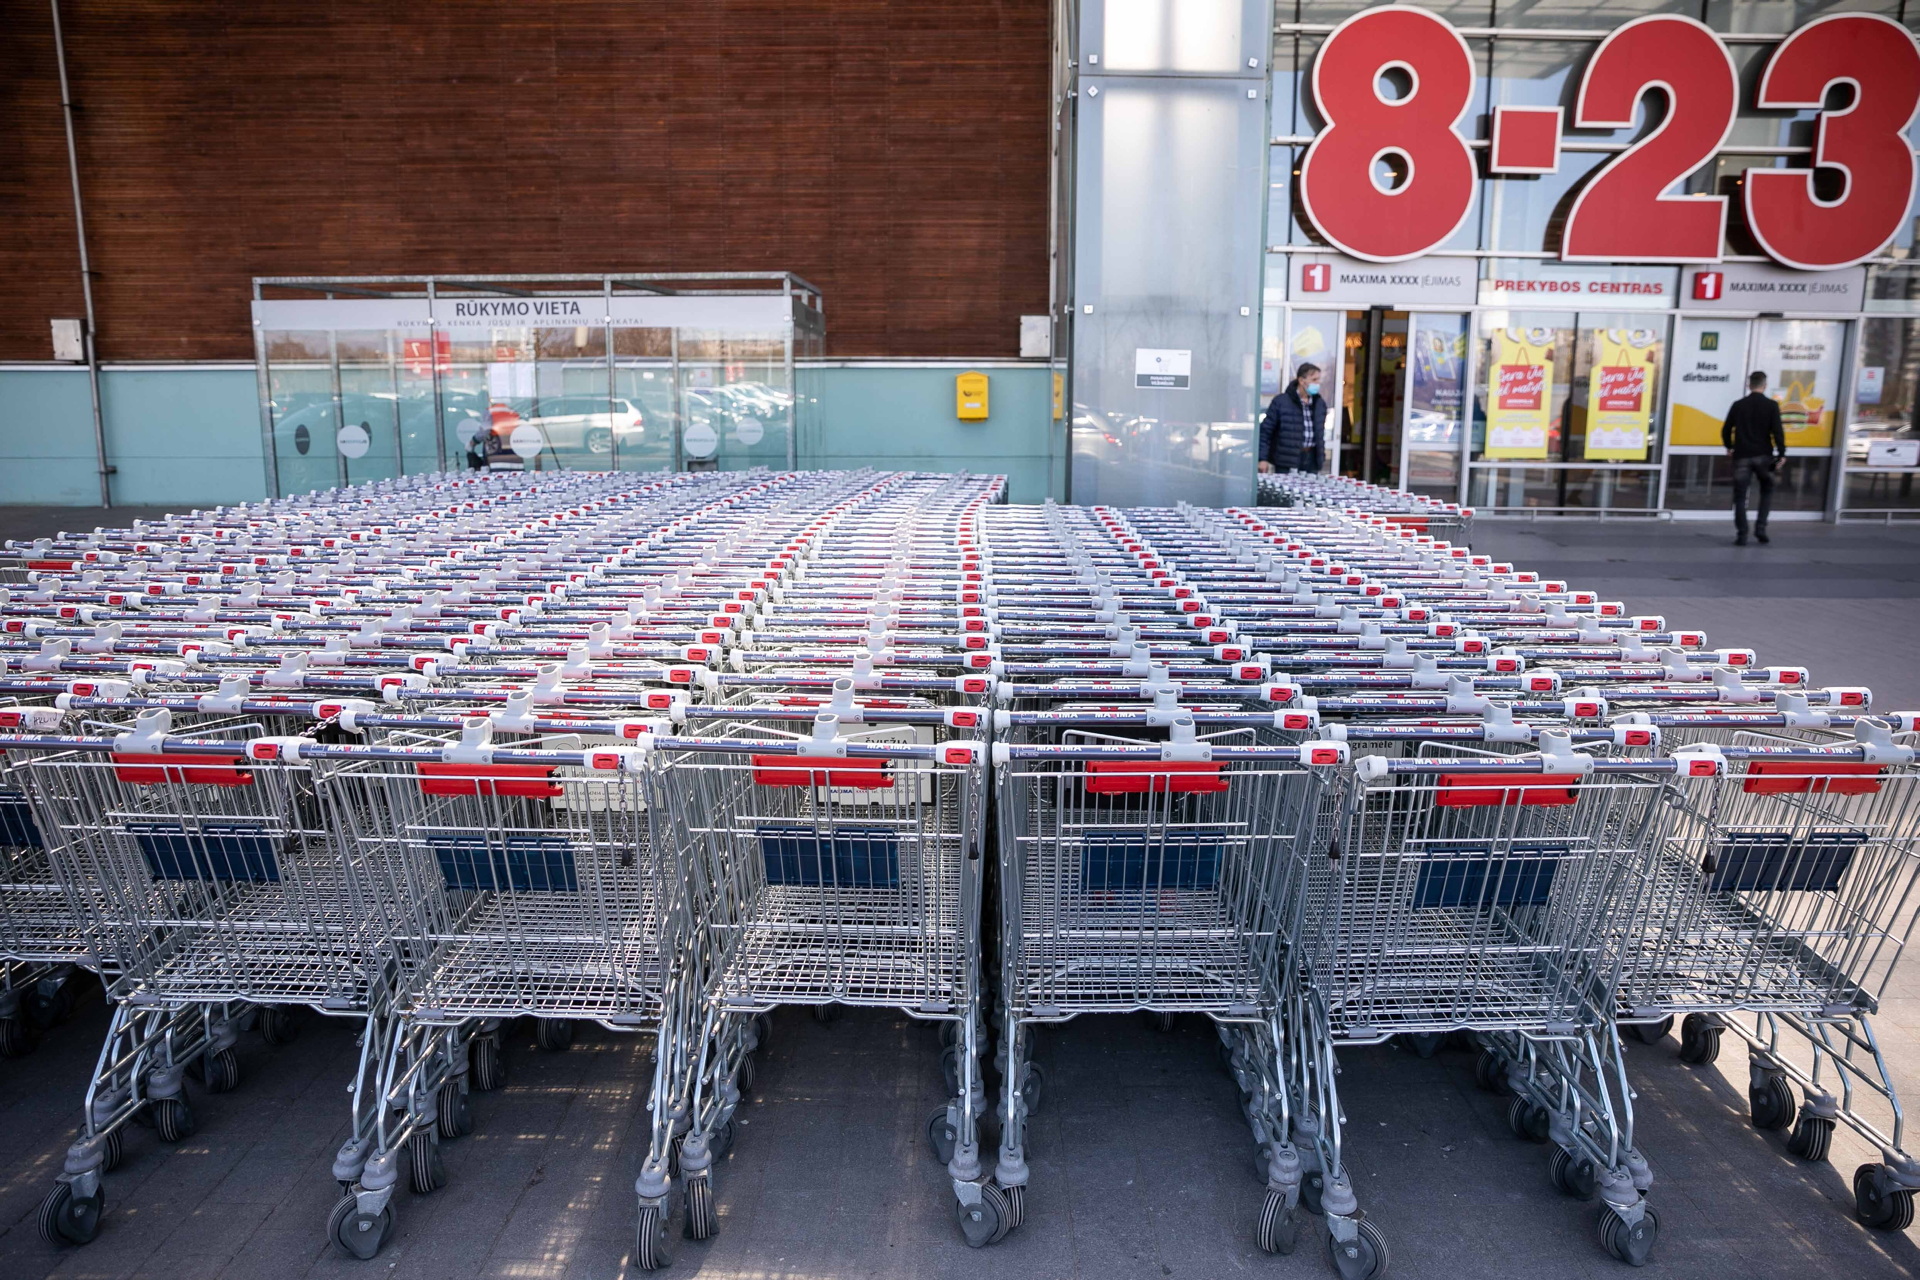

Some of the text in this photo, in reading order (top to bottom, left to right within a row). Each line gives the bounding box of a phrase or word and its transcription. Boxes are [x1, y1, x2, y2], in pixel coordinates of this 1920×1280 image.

[1310, 265, 1324, 290] 1
[1340, 274, 1387, 284] MAXIMA
[1390, 276, 1419, 285] XXXX
[1494, 280, 1663, 294] PREKYBOS CENTRAS
[1702, 273, 1716, 298] 1
[1730, 282, 1775, 292] MAXIMA
[1778, 284, 1807, 293] XXXX
[456, 300, 581, 316] RŪKYMO VIETA
[1696, 362, 1718, 370] Mes
[1682, 374, 1730, 382] dirbame!
